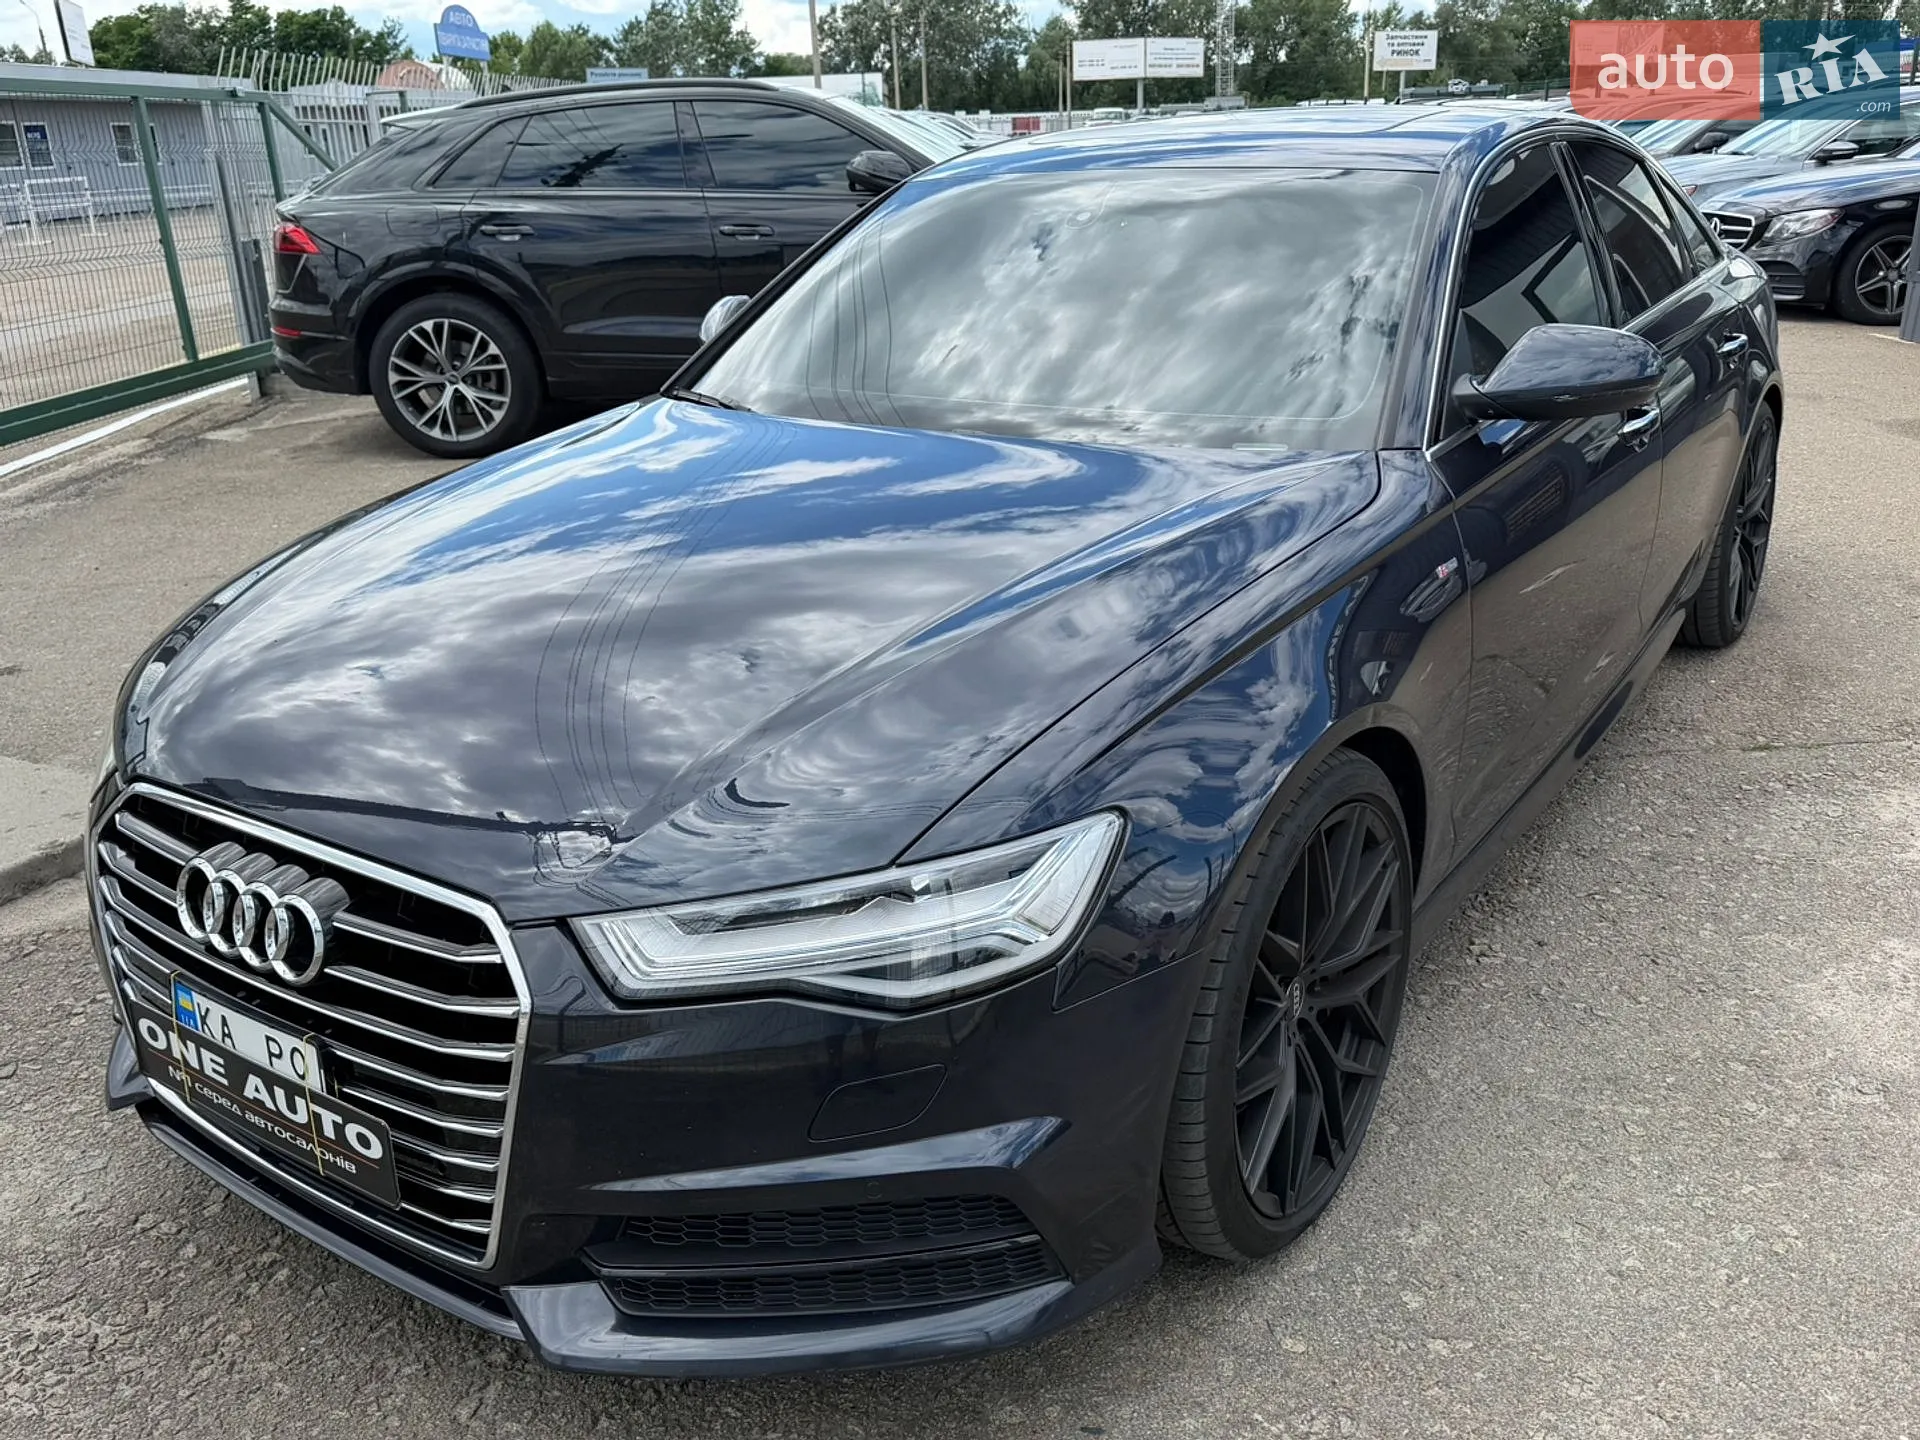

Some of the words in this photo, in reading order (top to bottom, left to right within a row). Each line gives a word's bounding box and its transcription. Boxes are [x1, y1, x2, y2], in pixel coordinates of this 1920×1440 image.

[449, 11, 474, 28] АВТО
[1385, 33, 1428, 41] Запчастини
[1391, 49, 1421, 57] РИНОК
[138, 1018, 229, 1086] ONE
[243, 1073, 383, 1160] AUTO
[194, 1082, 244, 1117] серед
[244, 1109, 358, 1175] автосалонів
